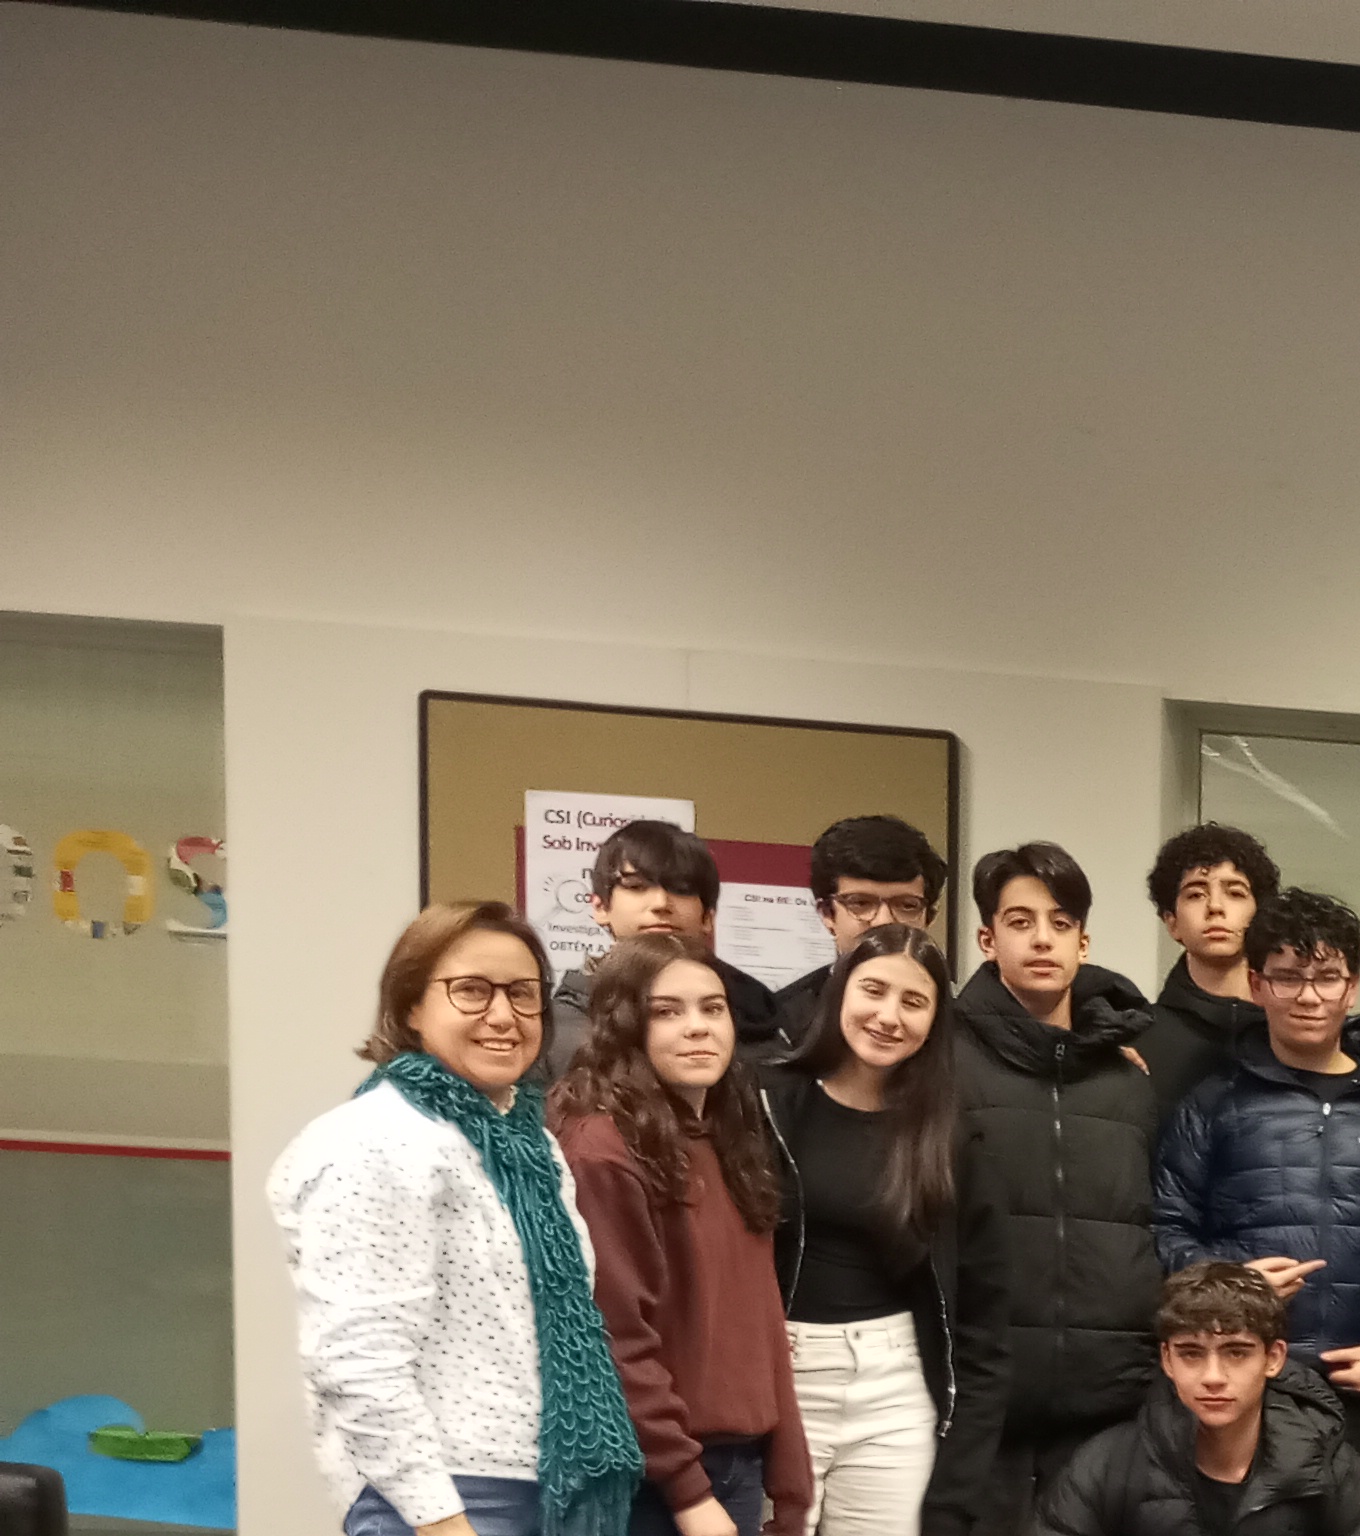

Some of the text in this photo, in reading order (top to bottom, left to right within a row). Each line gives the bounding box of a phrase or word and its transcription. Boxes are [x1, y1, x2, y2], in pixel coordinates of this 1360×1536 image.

[544, 809, 571, 824] CSI
[542, 834, 602, 852] Sob Inv
